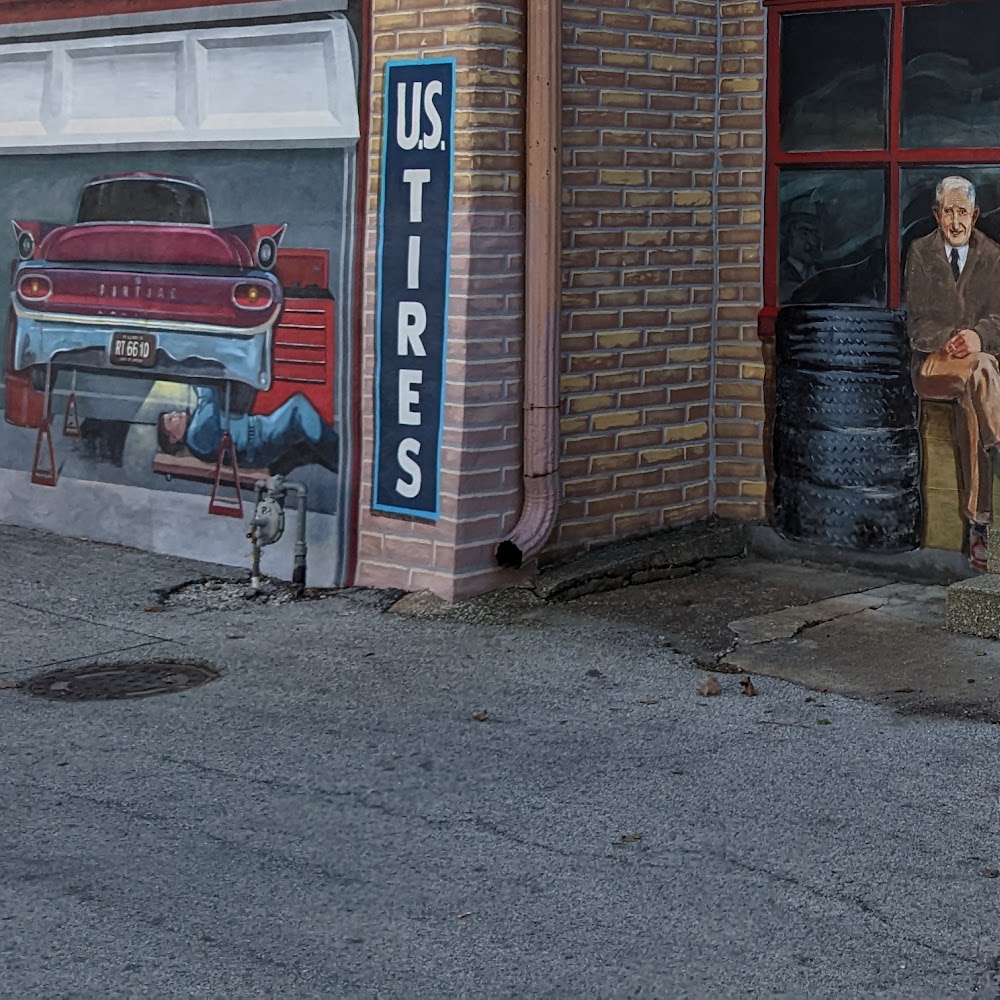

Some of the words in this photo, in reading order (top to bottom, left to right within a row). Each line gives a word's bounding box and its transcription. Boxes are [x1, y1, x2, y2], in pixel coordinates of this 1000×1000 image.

[396, 80, 445, 152] U.S.
[115, 340, 126, 355] RT
[394, 167, 432, 499] TIRES
